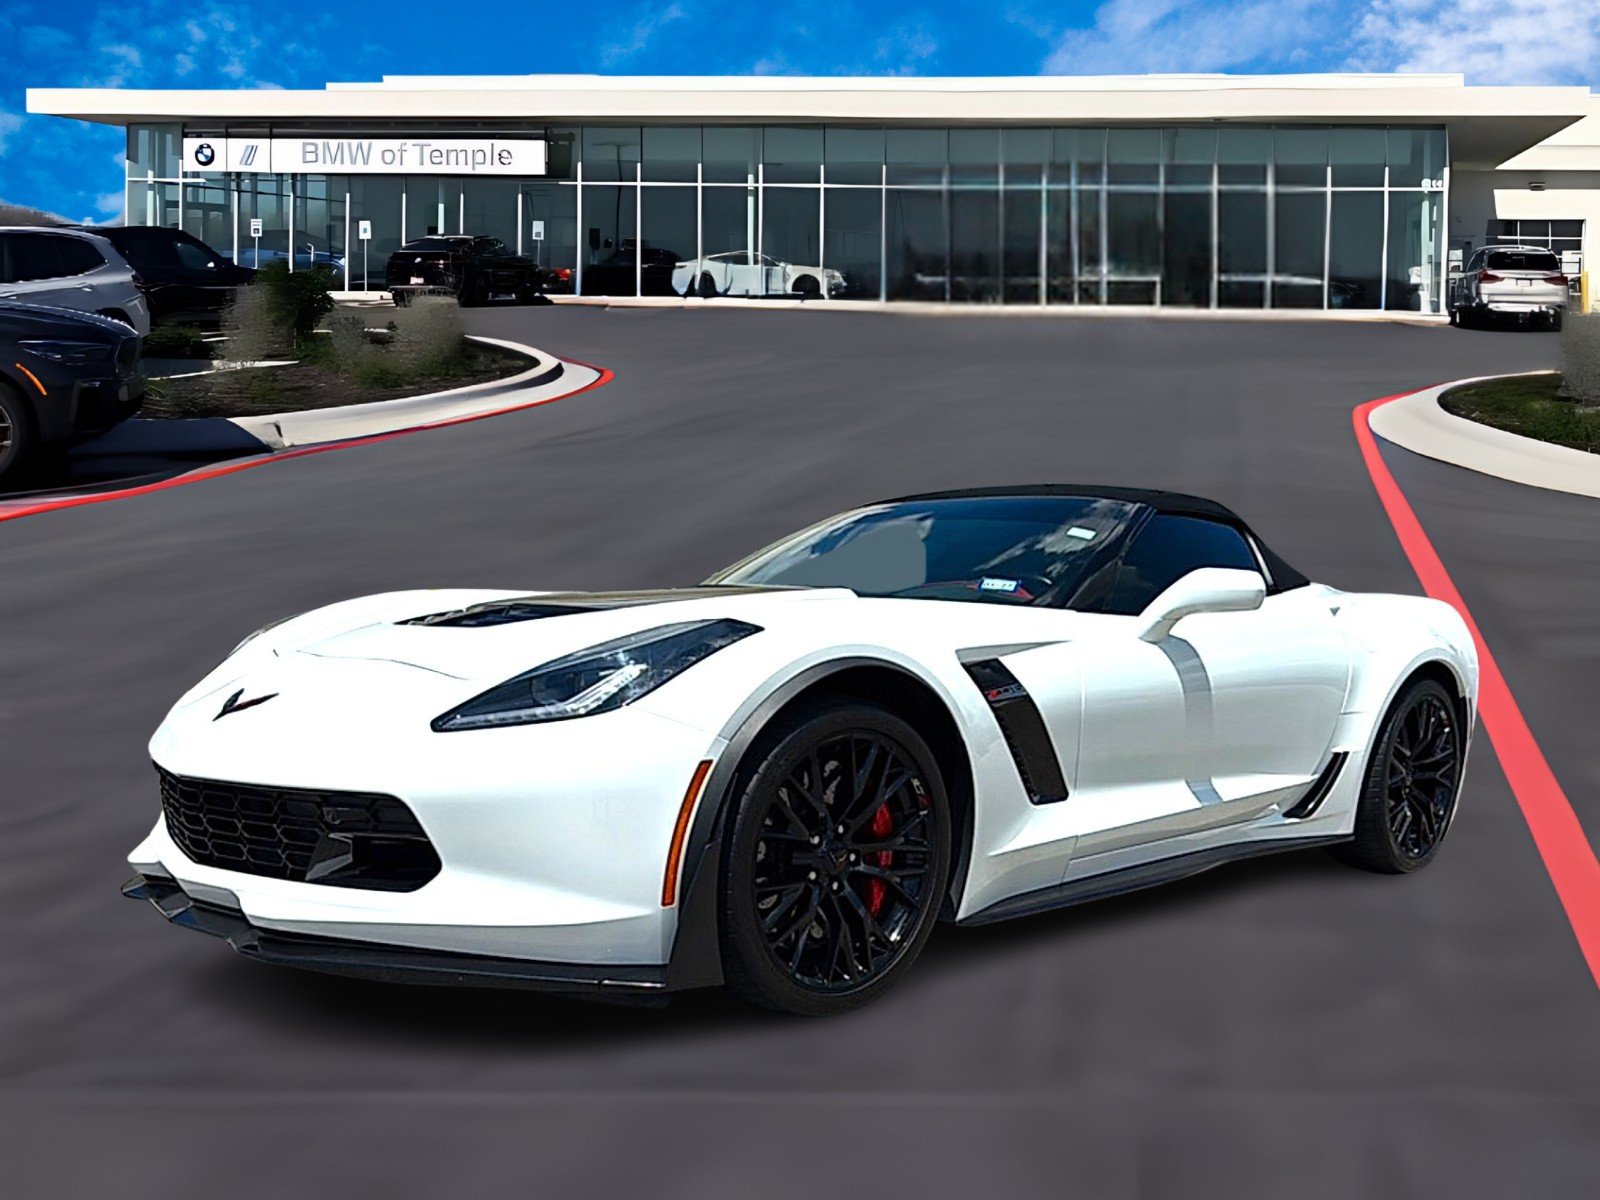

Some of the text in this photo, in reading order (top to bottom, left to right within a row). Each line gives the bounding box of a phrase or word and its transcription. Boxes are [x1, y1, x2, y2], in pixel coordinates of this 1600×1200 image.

[301, 141, 513, 171] BMW of Temple
